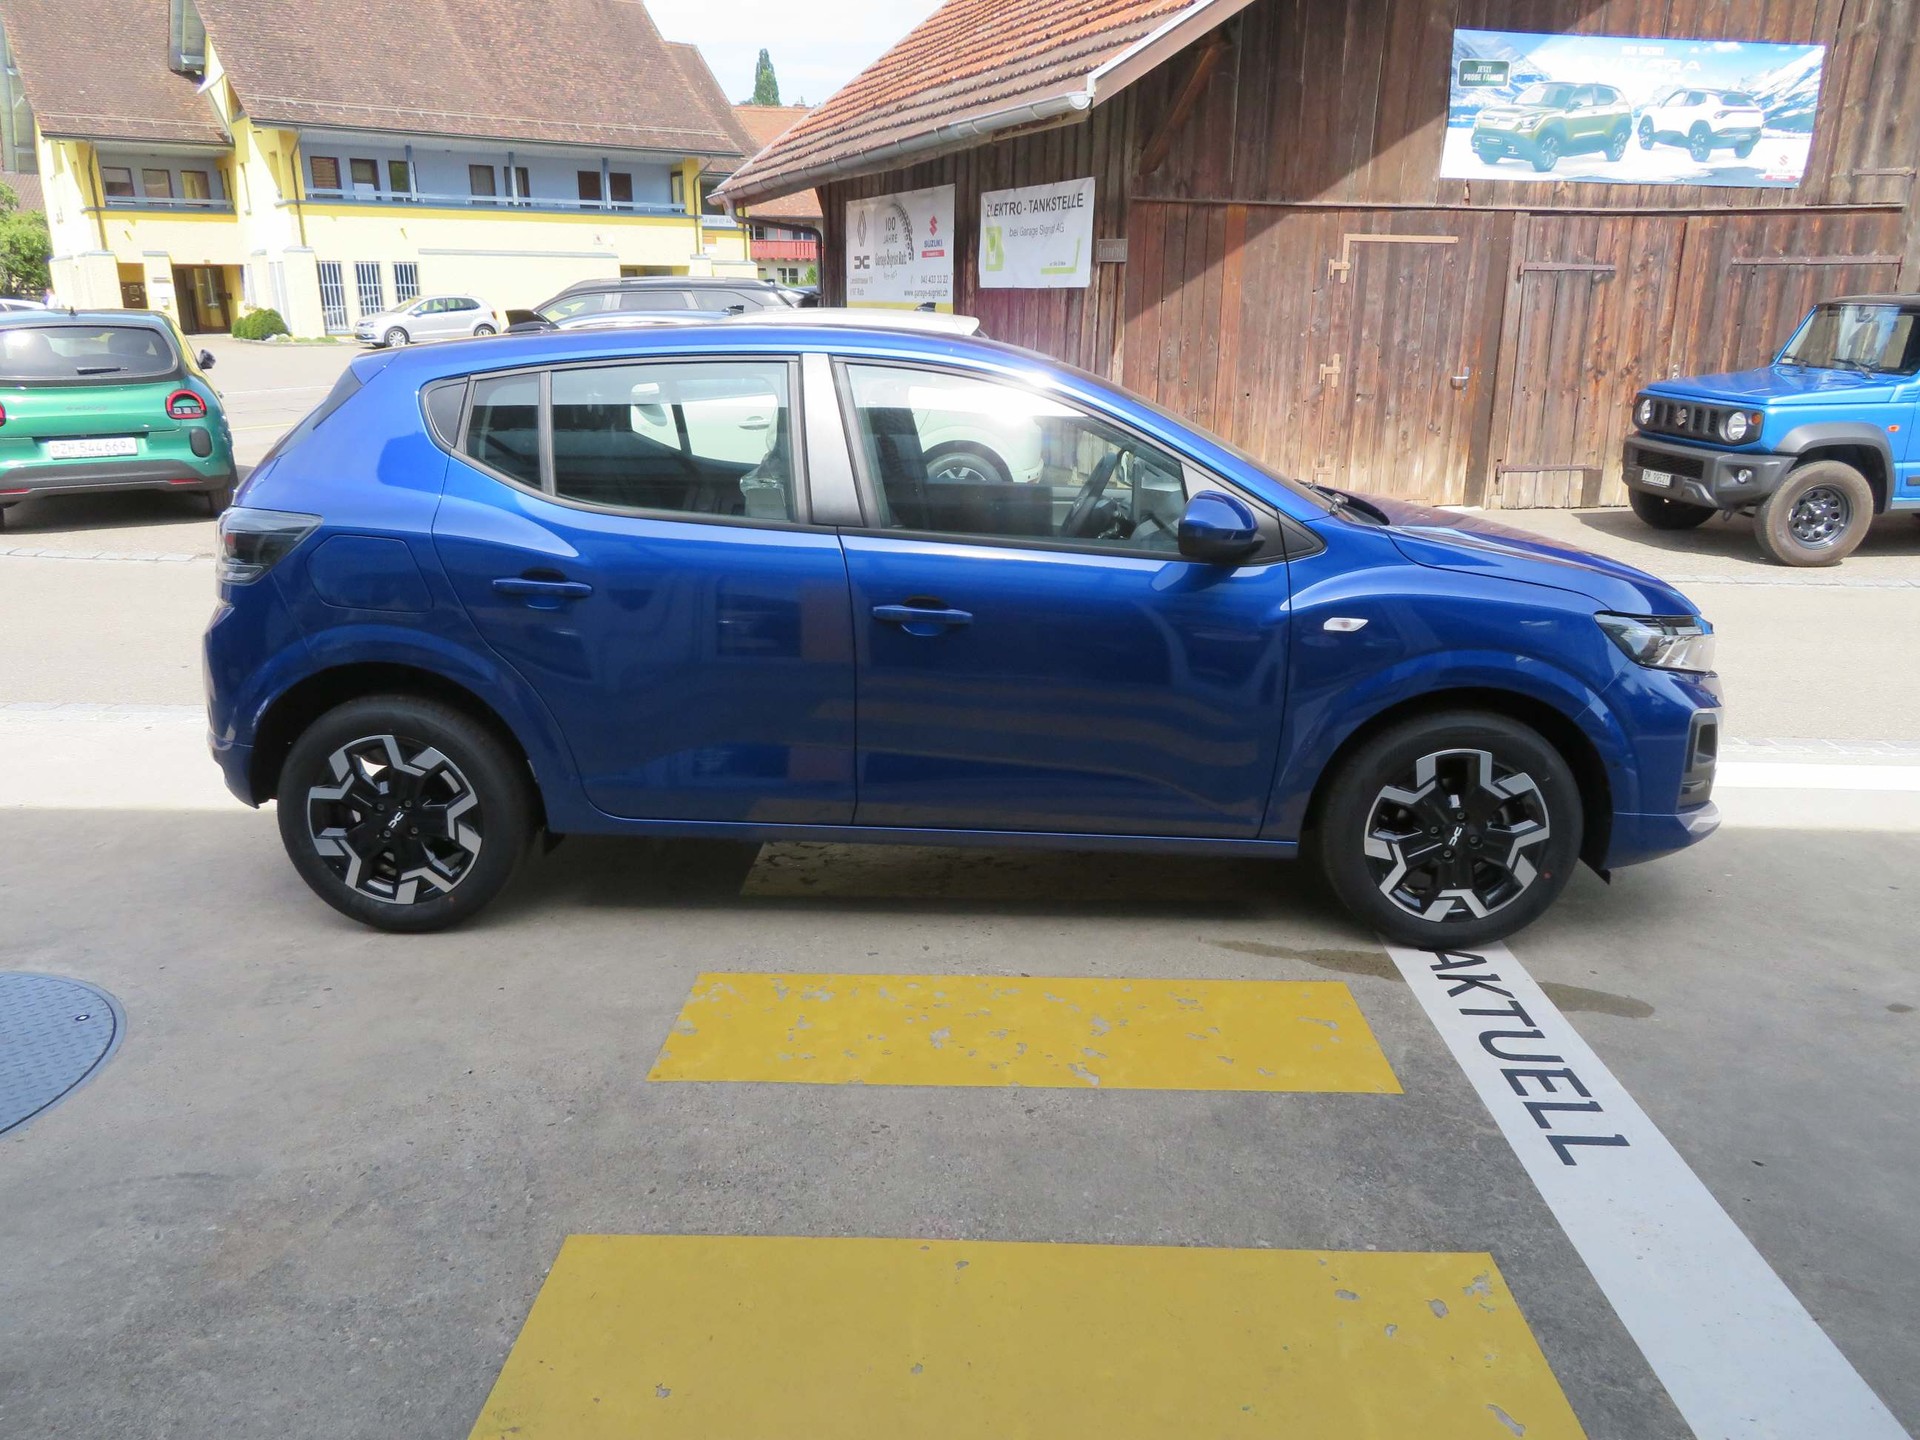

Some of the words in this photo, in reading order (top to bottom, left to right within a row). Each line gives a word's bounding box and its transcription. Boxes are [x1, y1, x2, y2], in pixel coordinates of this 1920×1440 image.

[986, 201, 1022, 218] ELEKTRO
[1028, 192, 1084, 214] TANKSTELLE
[885, 216, 896, 231] 100
[1020, 224, 1039, 238] Garage
[1056, 222, 1065, 234] AG
[923, 238, 943, 248] SUZUKI
[1419, 949, 1631, 1166] AKTUELL
